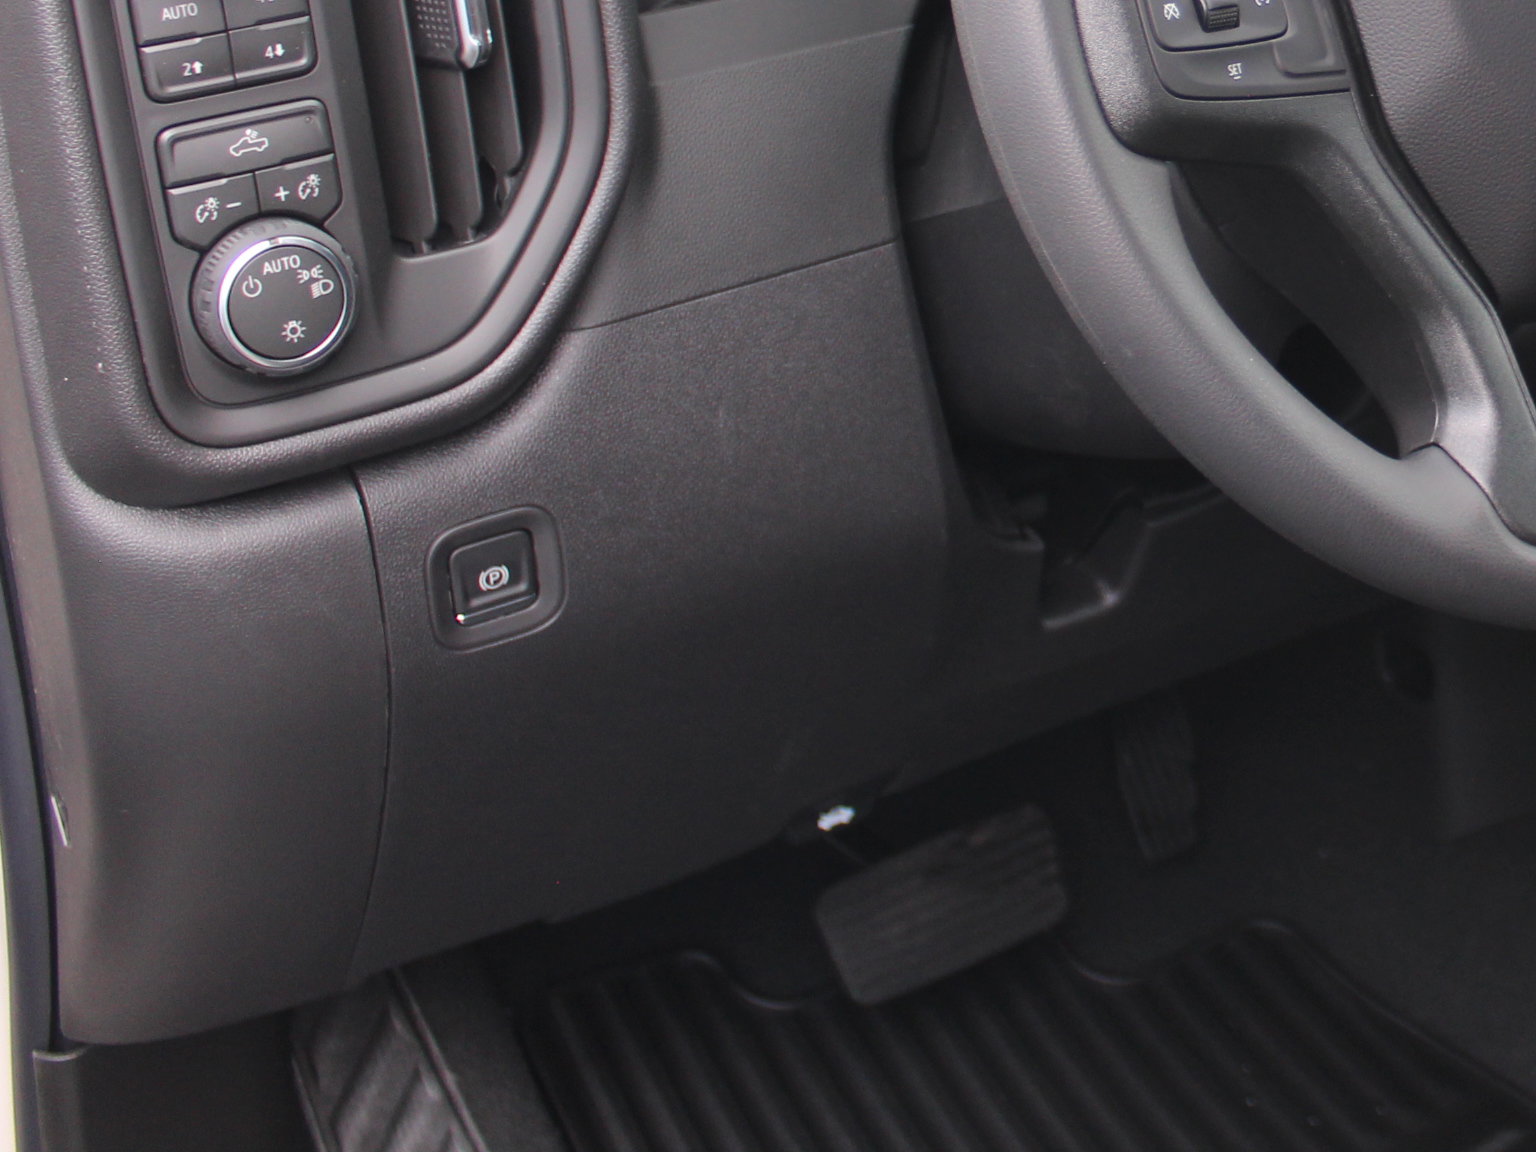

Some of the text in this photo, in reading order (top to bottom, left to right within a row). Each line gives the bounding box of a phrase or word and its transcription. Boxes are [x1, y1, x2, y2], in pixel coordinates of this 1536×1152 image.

[162, 2, 198, 21] AUTO
[1227, 62, 1242, 77] SET
[262, 254, 301, 276] AUTO
